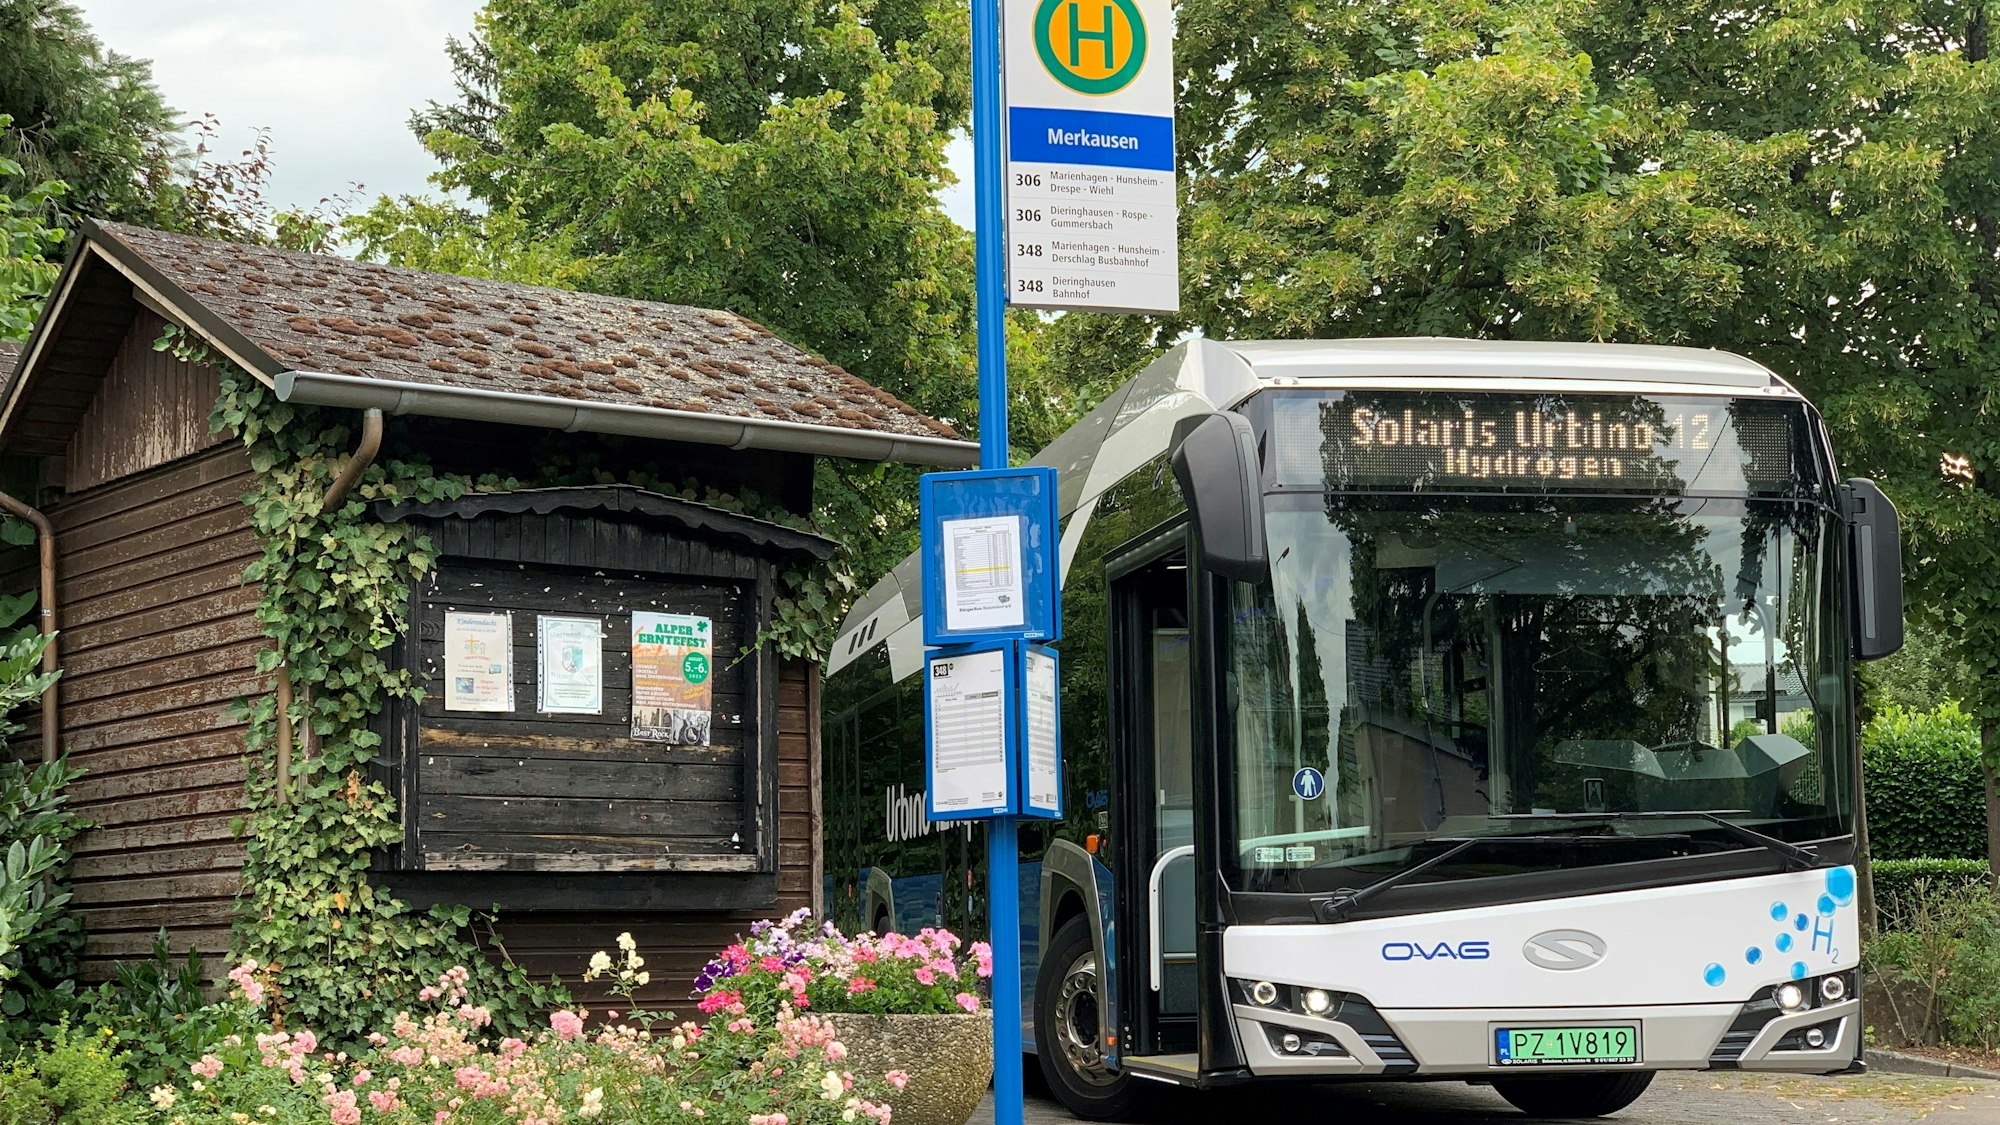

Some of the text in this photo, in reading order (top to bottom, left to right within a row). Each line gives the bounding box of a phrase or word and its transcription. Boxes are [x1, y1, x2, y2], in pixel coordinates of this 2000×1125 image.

[1048, 128, 1139, 150] Merkausen
[1015, 174, 1042, 187] 306
[1050, 171, 1109, 184] Marienhagen
[1116, 174, 1158, 186] Hunsheim
[1050, 184, 1081, 196] Drespe
[1089, 185, 1114, 196] Wiehl
[1016, 209, 1042, 222] 306
[1050, 206, 1114, 221] Dieringhausen
[1122, 210, 1148, 221] Rospe
[1051, 219, 1113, 230] Gummersbach
[1017, 244, 1043, 257] 348
[1051, 241, 1110, 254] Marienhagen
[1118, 244, 1160, 256] Hunsheim
[1052, 254, 1150, 268] Derschlag Busbahnhof
[1018, 276, 1116, 293] 348 Dieringhausen
[1052, 289, 1090, 299] Bahnhof
[1352, 408, 1709, 449] Solaris Urbino 12
[1445, 448, 1622, 480] Hydrogen
[655, 623, 693, 636] ALPER
[638, 633, 707, 648] ERNTEFEST
[685, 662, 707, 674] 5.-6.
[934, 665, 947, 677] 348
[1382, 941, 1490, 961] OVAG
[1514, 1031, 1628, 1057] PZ 1V819
[1500, 1048, 1510, 1056] PL
